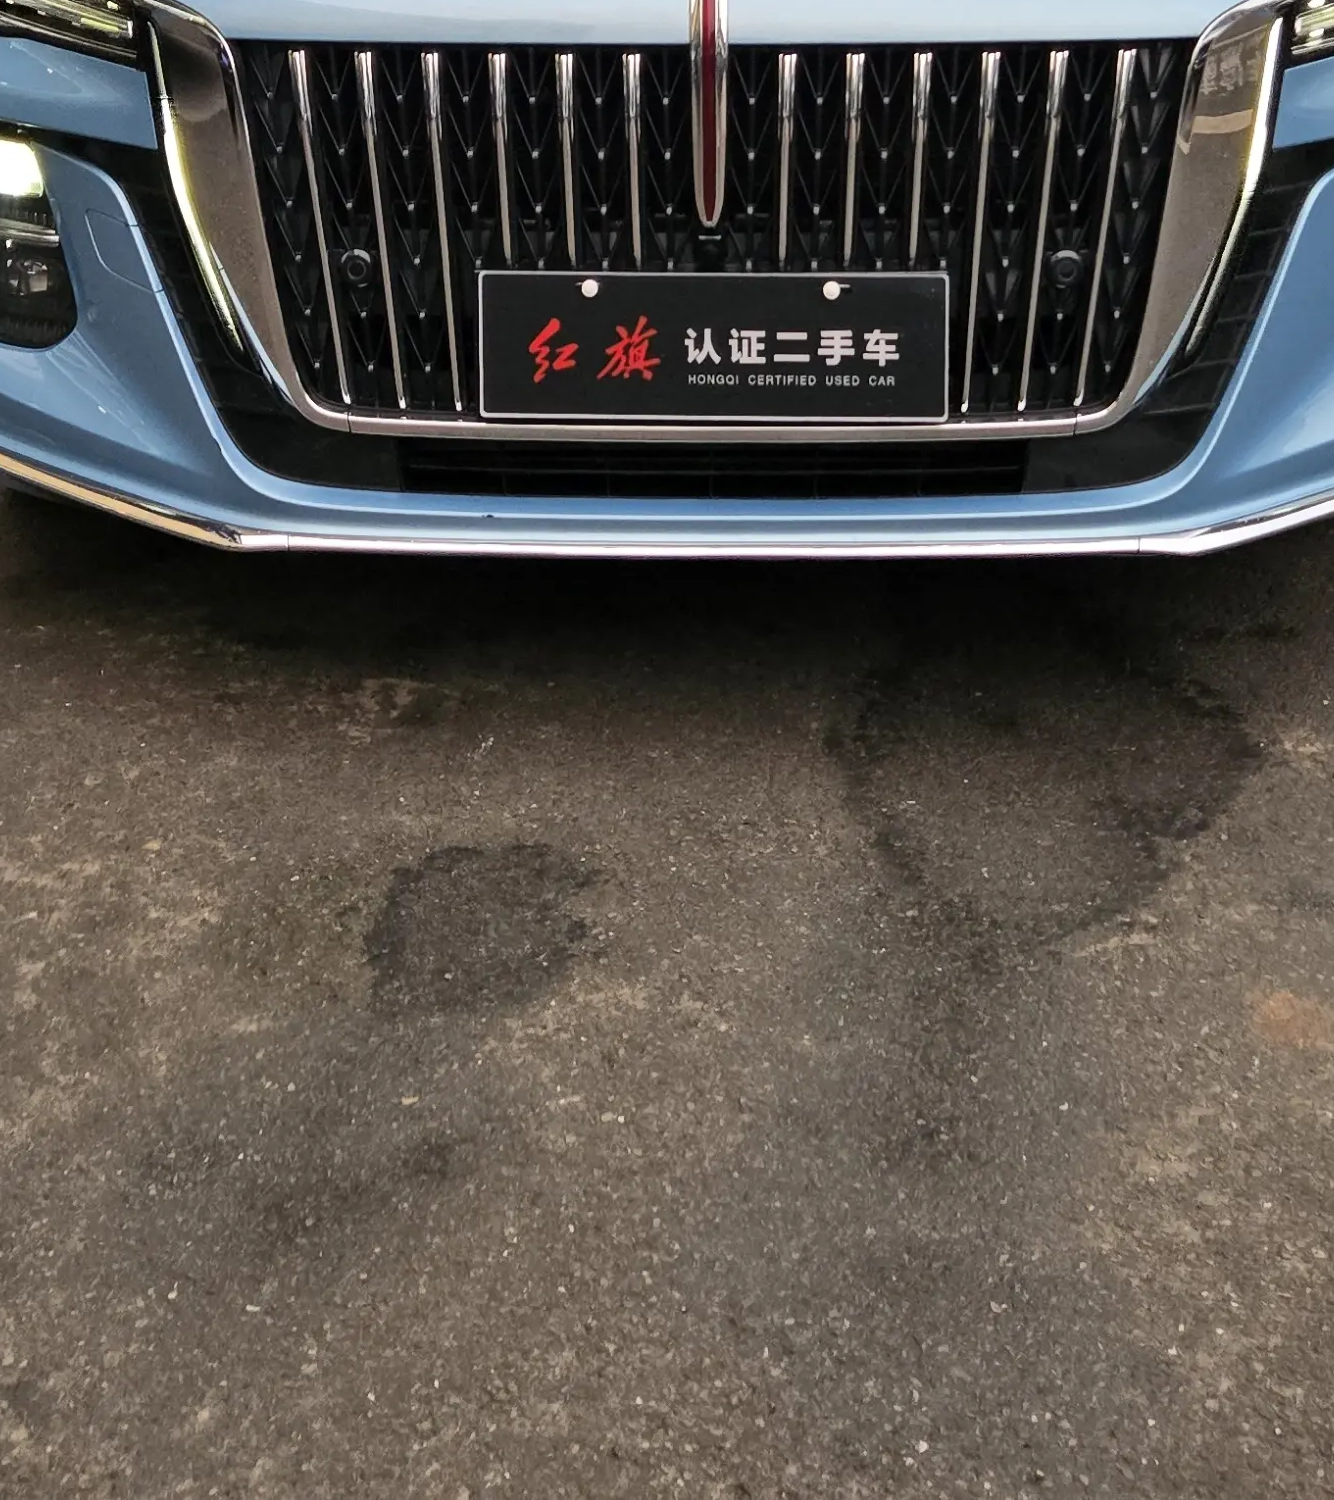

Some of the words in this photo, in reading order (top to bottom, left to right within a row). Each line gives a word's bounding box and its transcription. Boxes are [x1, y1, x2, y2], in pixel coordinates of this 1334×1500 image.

[684, 327, 901, 367] 认证二手车
[687, 373, 740, 386] HONGQI
[747, 374, 817, 387] CERTIFIED
[825, 374, 860, 387] USED
[868, 374, 896, 387] CAR
